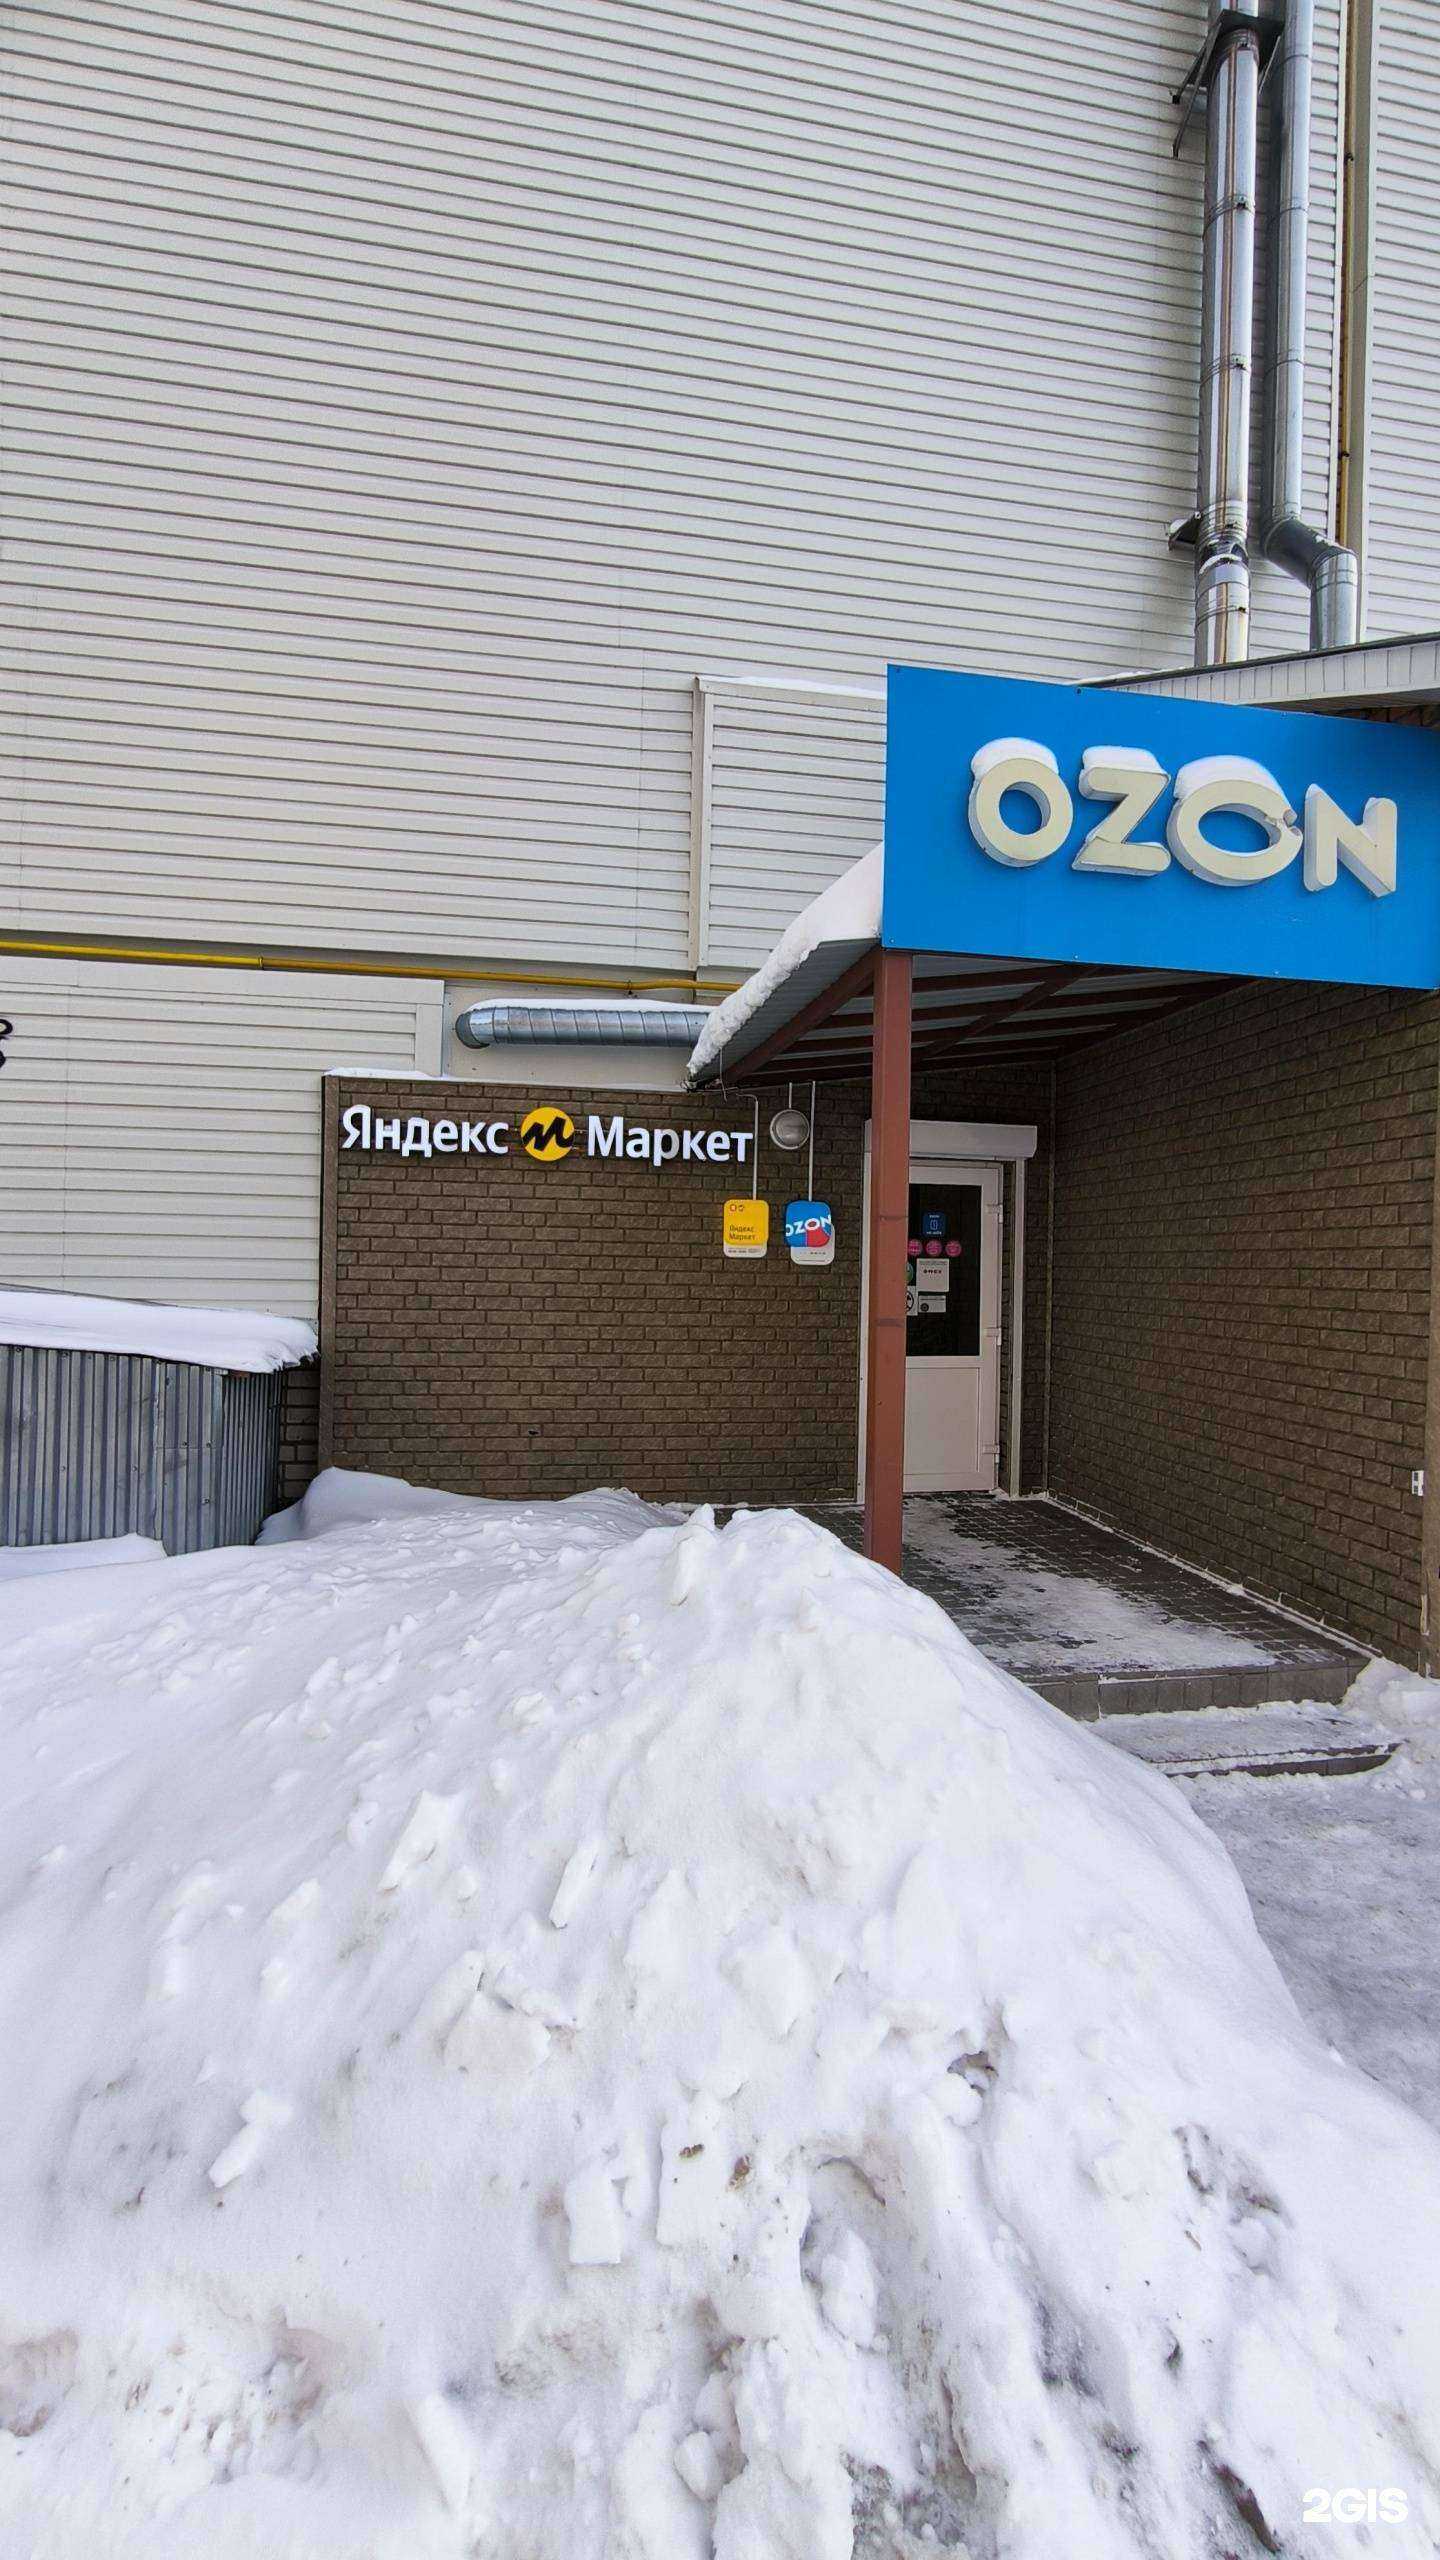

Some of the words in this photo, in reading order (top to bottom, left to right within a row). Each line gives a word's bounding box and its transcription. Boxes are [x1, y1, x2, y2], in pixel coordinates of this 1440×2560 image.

[967, 737, 1399, 897] OZON
[342, 1104, 509, 1158] Яндекс
[586, 1115, 753, 1166] Маркет
[785, 1214, 831, 1236] OZON
